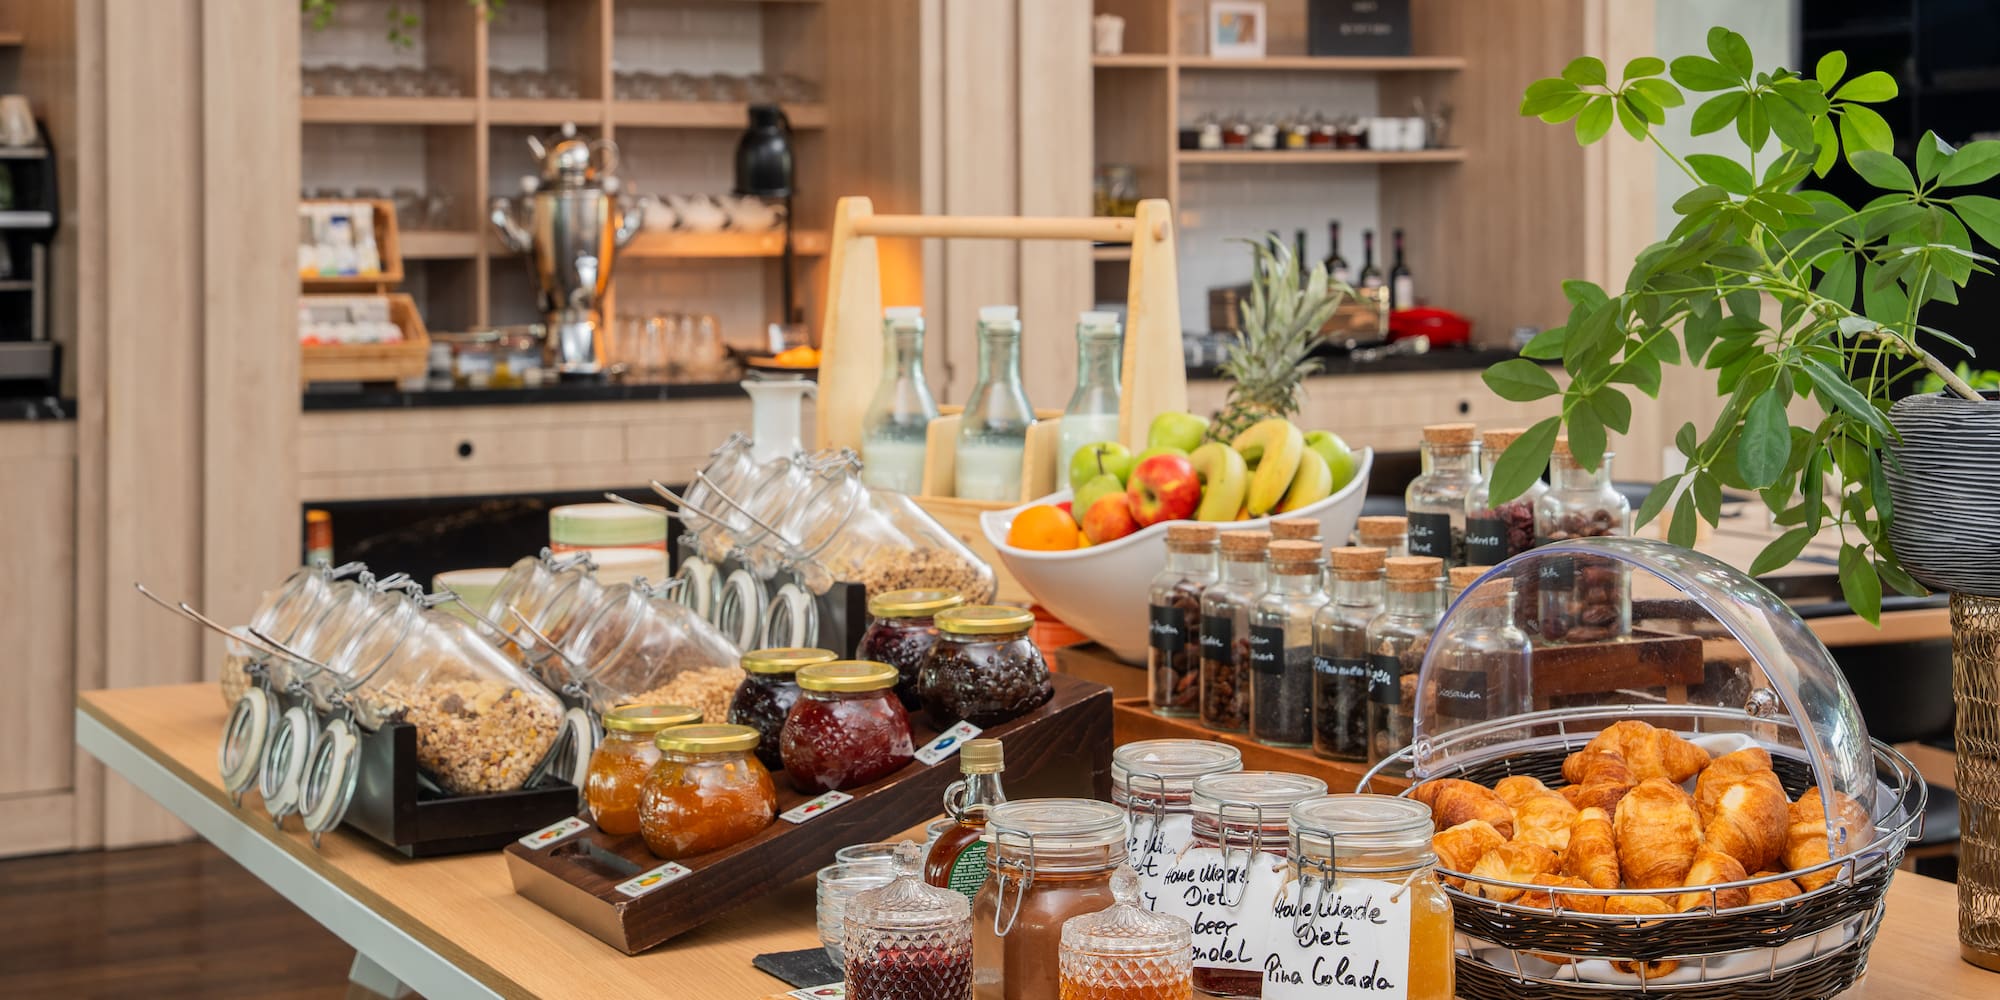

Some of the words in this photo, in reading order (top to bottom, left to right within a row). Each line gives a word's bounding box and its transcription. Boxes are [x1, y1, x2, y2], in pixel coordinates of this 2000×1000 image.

[1183, 884, 1231, 907] Diet
[1191, 911, 1238, 936] beer
[1296, 921, 1351, 948] Diet
[1192, 936, 1253, 963] andel
[1312, 956, 1395, 990] Colada
